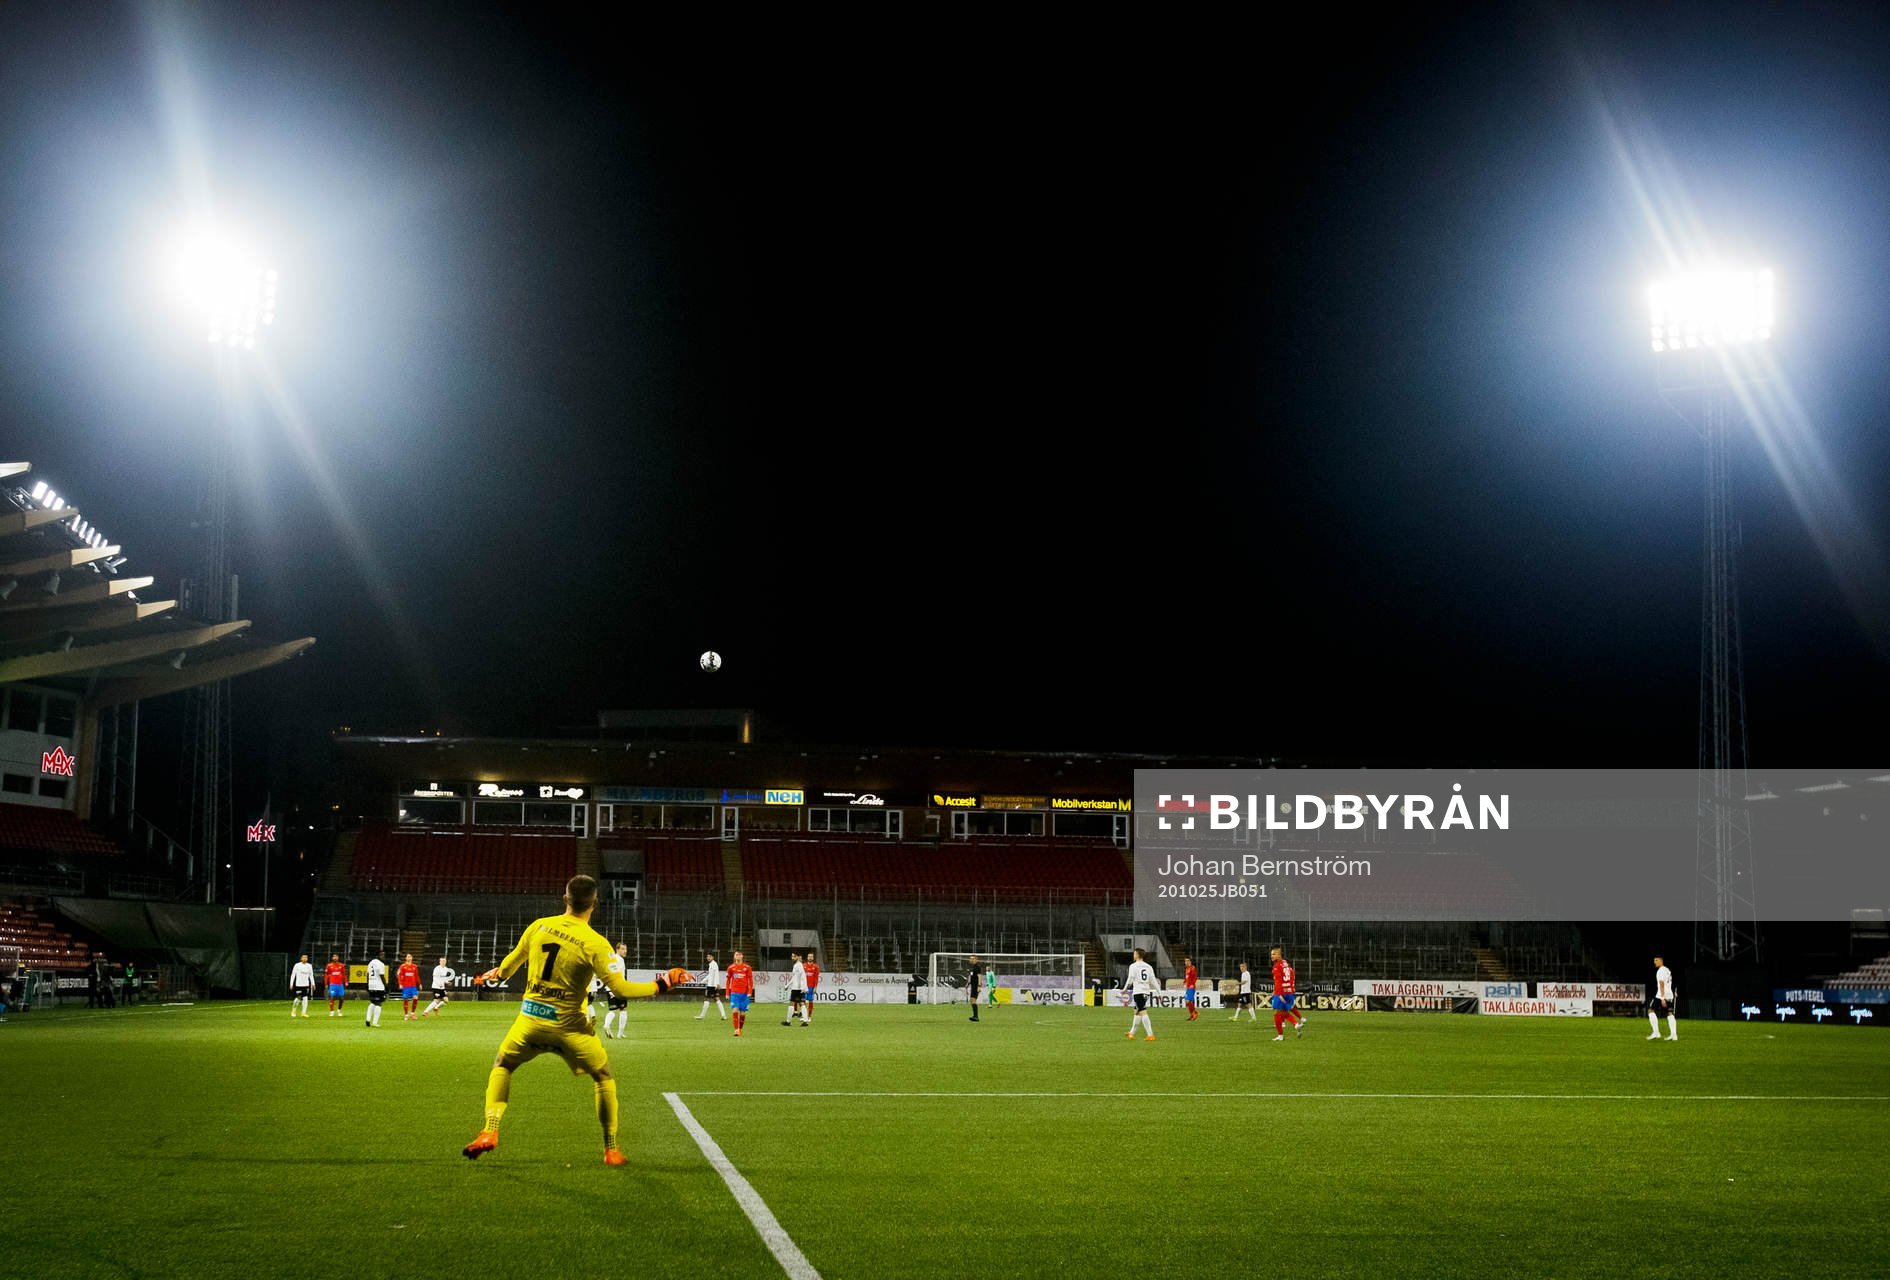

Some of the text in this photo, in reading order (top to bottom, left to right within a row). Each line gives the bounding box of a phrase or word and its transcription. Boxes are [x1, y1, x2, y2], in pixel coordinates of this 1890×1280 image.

[41, 745, 75, 777] MAX
[945, 796, 977, 807] Accesit
[1052, 798, 1117, 809] Mobilverkstan
[541, 942, 561, 982] 1
[858, 976, 884, 984] Carlsson
[1141, 969, 1147, 981] 6
[1031, 988, 1076, 1002] weber
[1371, 982, 1444, 996] TAKLÄGGAR'N
[1393, 996, 1445, 1009] ADMIT
[1482, 1000, 1556, 1014] TAKLÄGGAR'N
